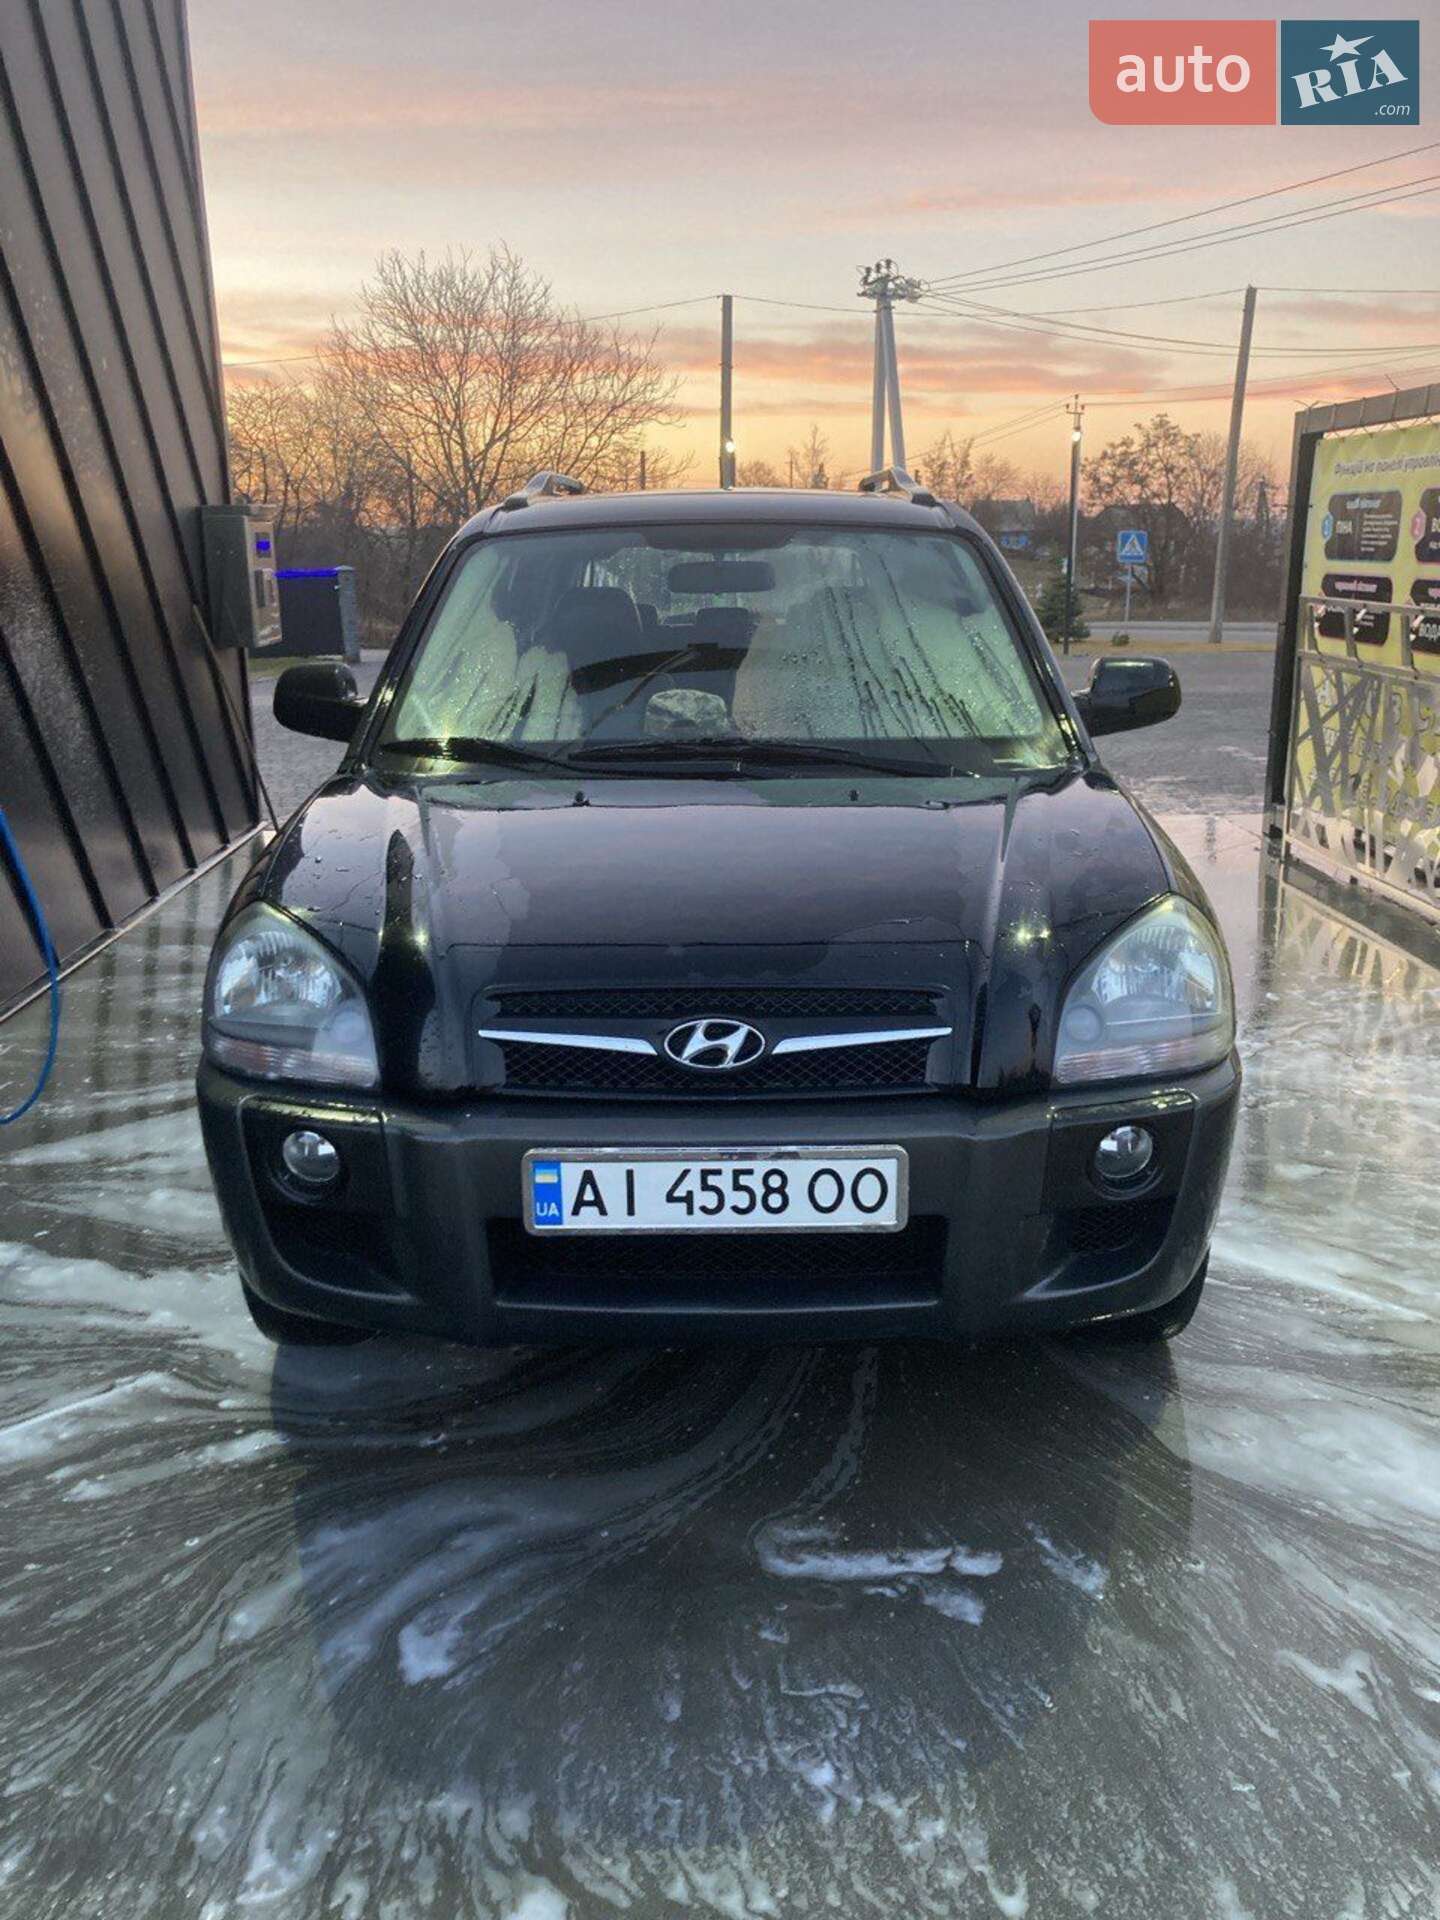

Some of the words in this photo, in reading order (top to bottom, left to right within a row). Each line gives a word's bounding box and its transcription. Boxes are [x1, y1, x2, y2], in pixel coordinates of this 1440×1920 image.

[570, 1168, 635, 1216] AI
[665, 1168, 789, 1216] 4558
[535, 1202, 561, 1218] UA
